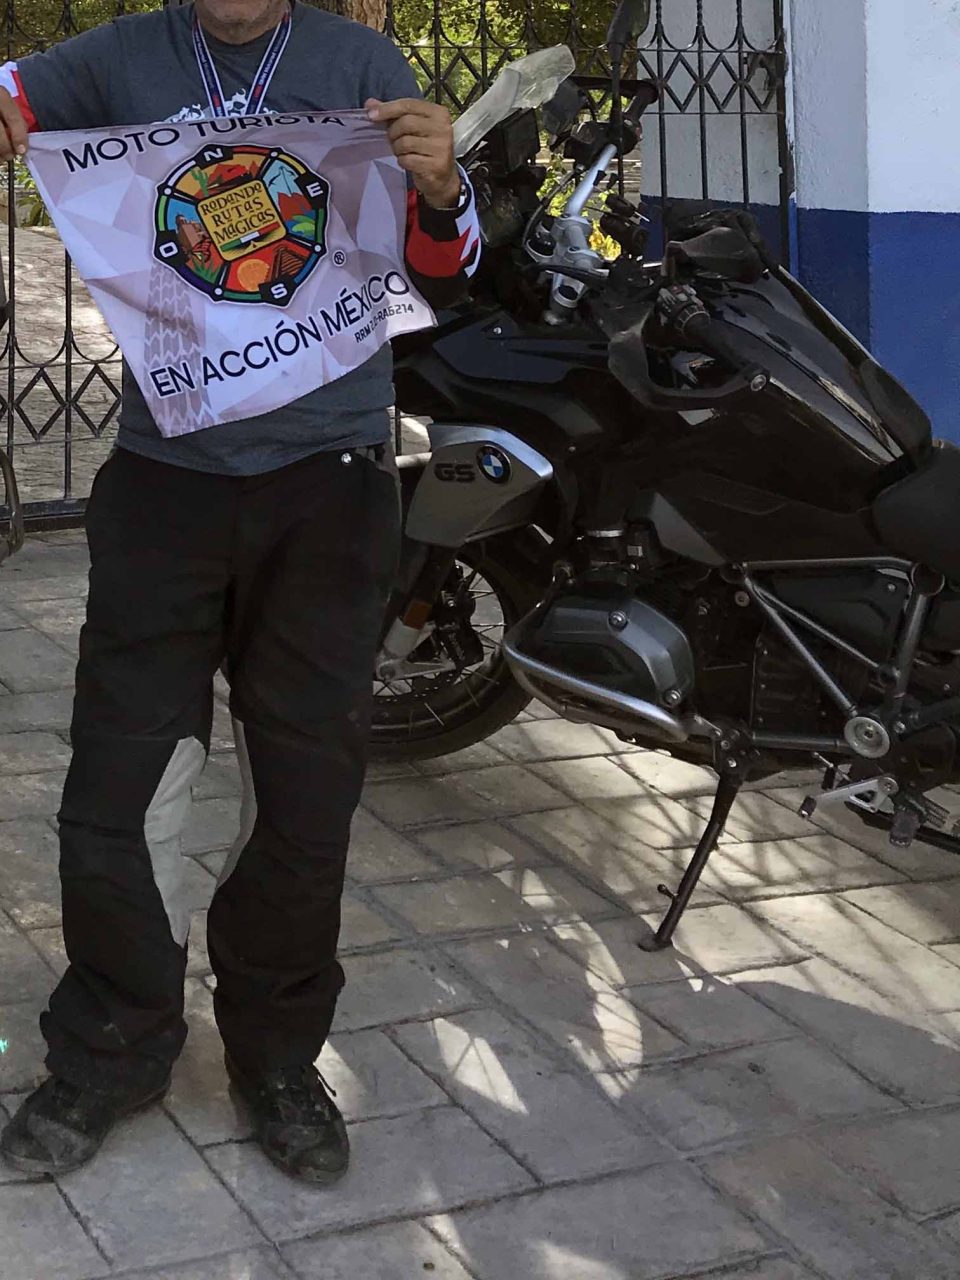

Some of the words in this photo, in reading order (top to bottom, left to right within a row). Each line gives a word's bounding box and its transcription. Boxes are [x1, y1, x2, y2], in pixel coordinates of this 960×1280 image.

[62, 127, 180, 172] MOTO
[189, 115, 346, 137] TURISTA
[204, 149, 224, 161] N
[307, 183, 323, 197] E
[159, 245, 178, 257] O
[271, 283, 287, 299] S
[150, 362, 195, 397] EN
[203, 317, 322, 386] ACCIÓN
[320, 271, 409, 336] MÉXICO
[434, 463, 476, 482] GS
